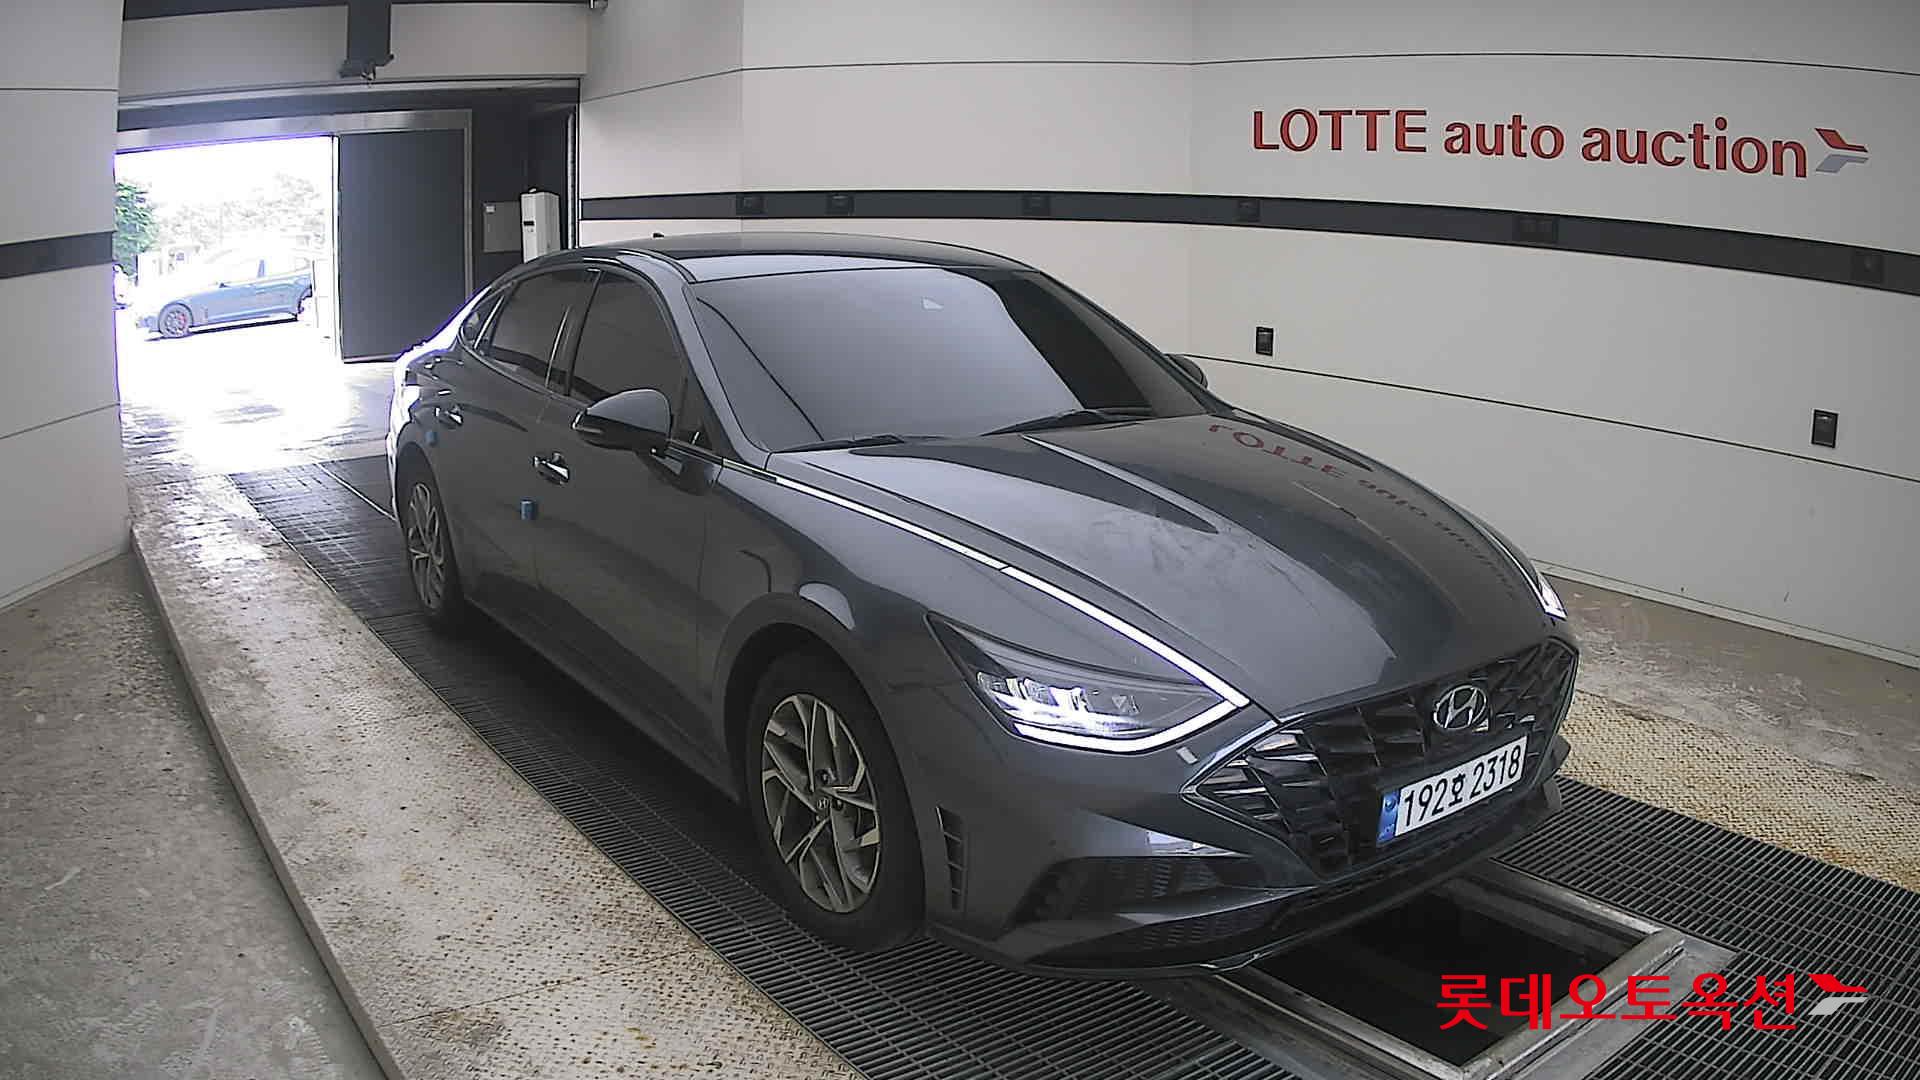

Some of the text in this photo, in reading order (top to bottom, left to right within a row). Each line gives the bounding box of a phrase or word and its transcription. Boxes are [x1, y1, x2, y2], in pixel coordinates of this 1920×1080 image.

[1252, 109, 1808, 179] LOTTE auto auction
[1403, 744, 1521, 827] 192호 2318
